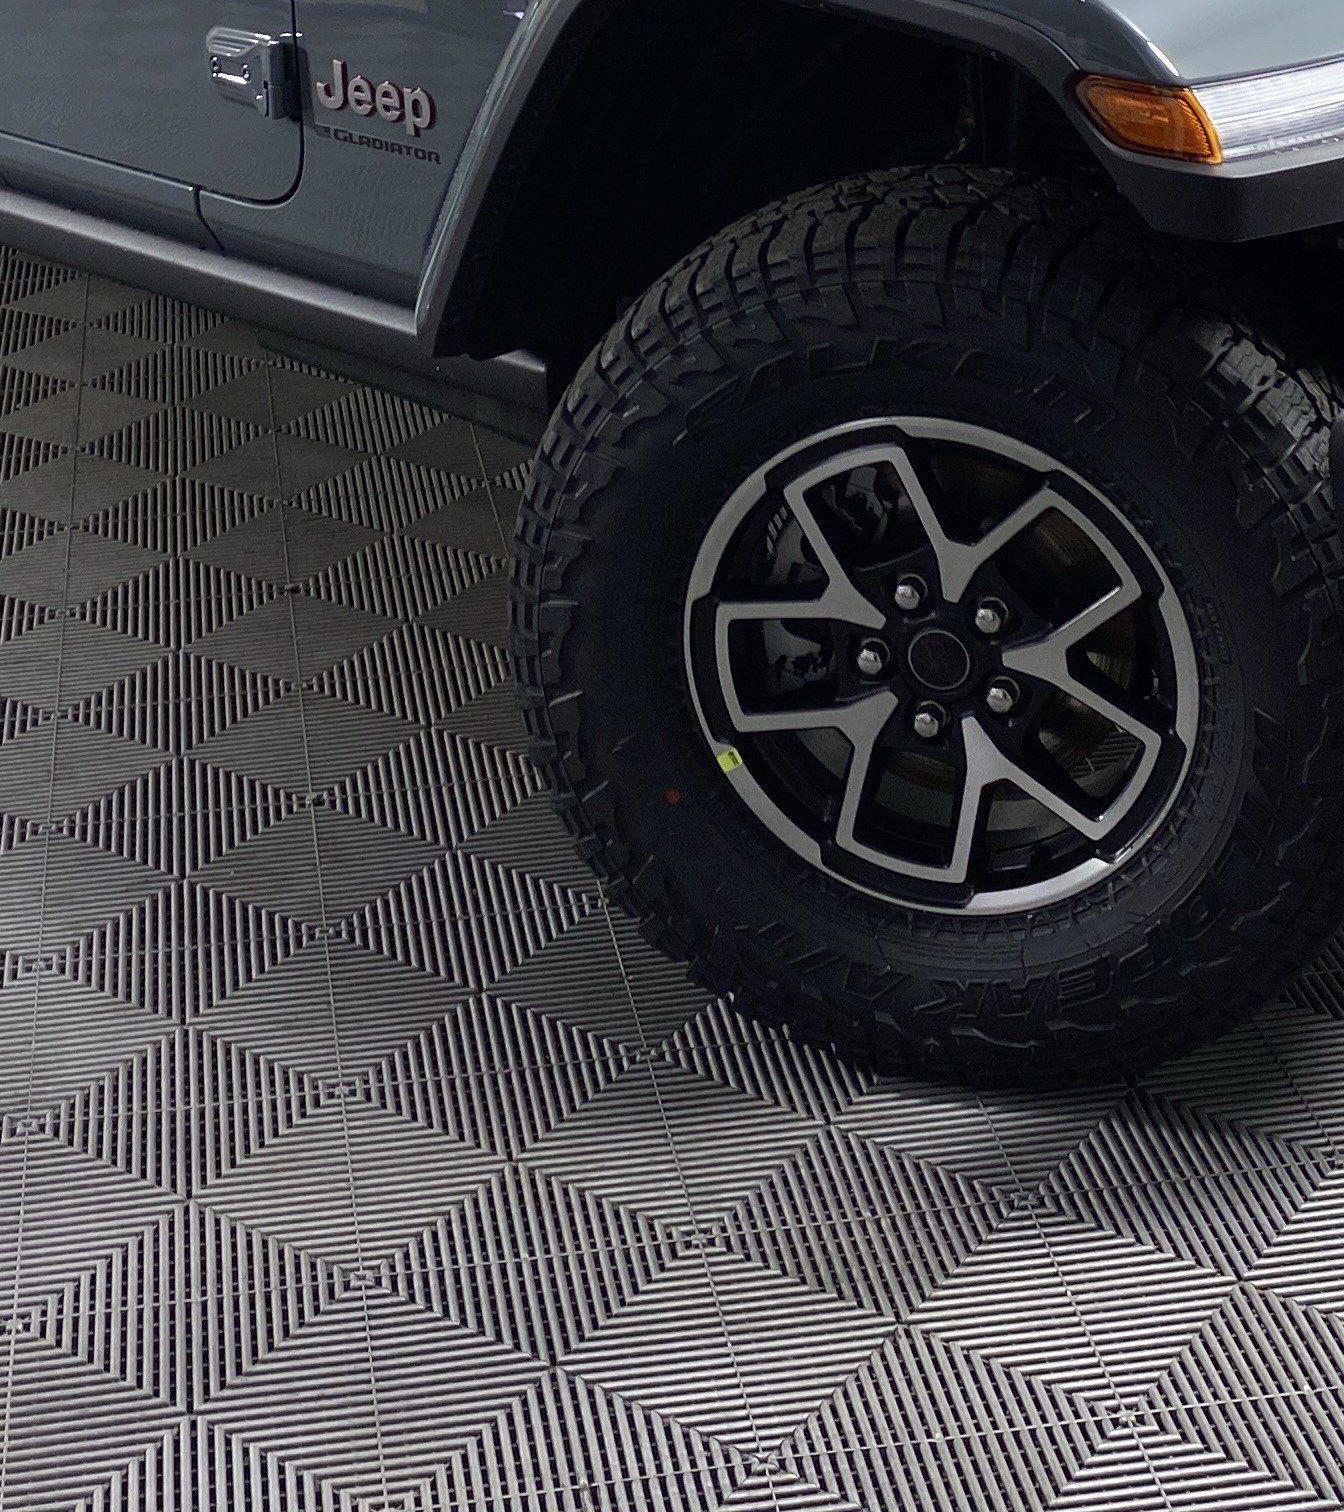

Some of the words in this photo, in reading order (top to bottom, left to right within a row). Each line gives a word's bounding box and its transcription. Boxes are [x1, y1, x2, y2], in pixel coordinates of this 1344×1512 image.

[316, 58, 436, 138] Jeep
[333, 128, 442, 165] GLADIATOR
[912, 706, 1304, 1019] WILDPEAK
